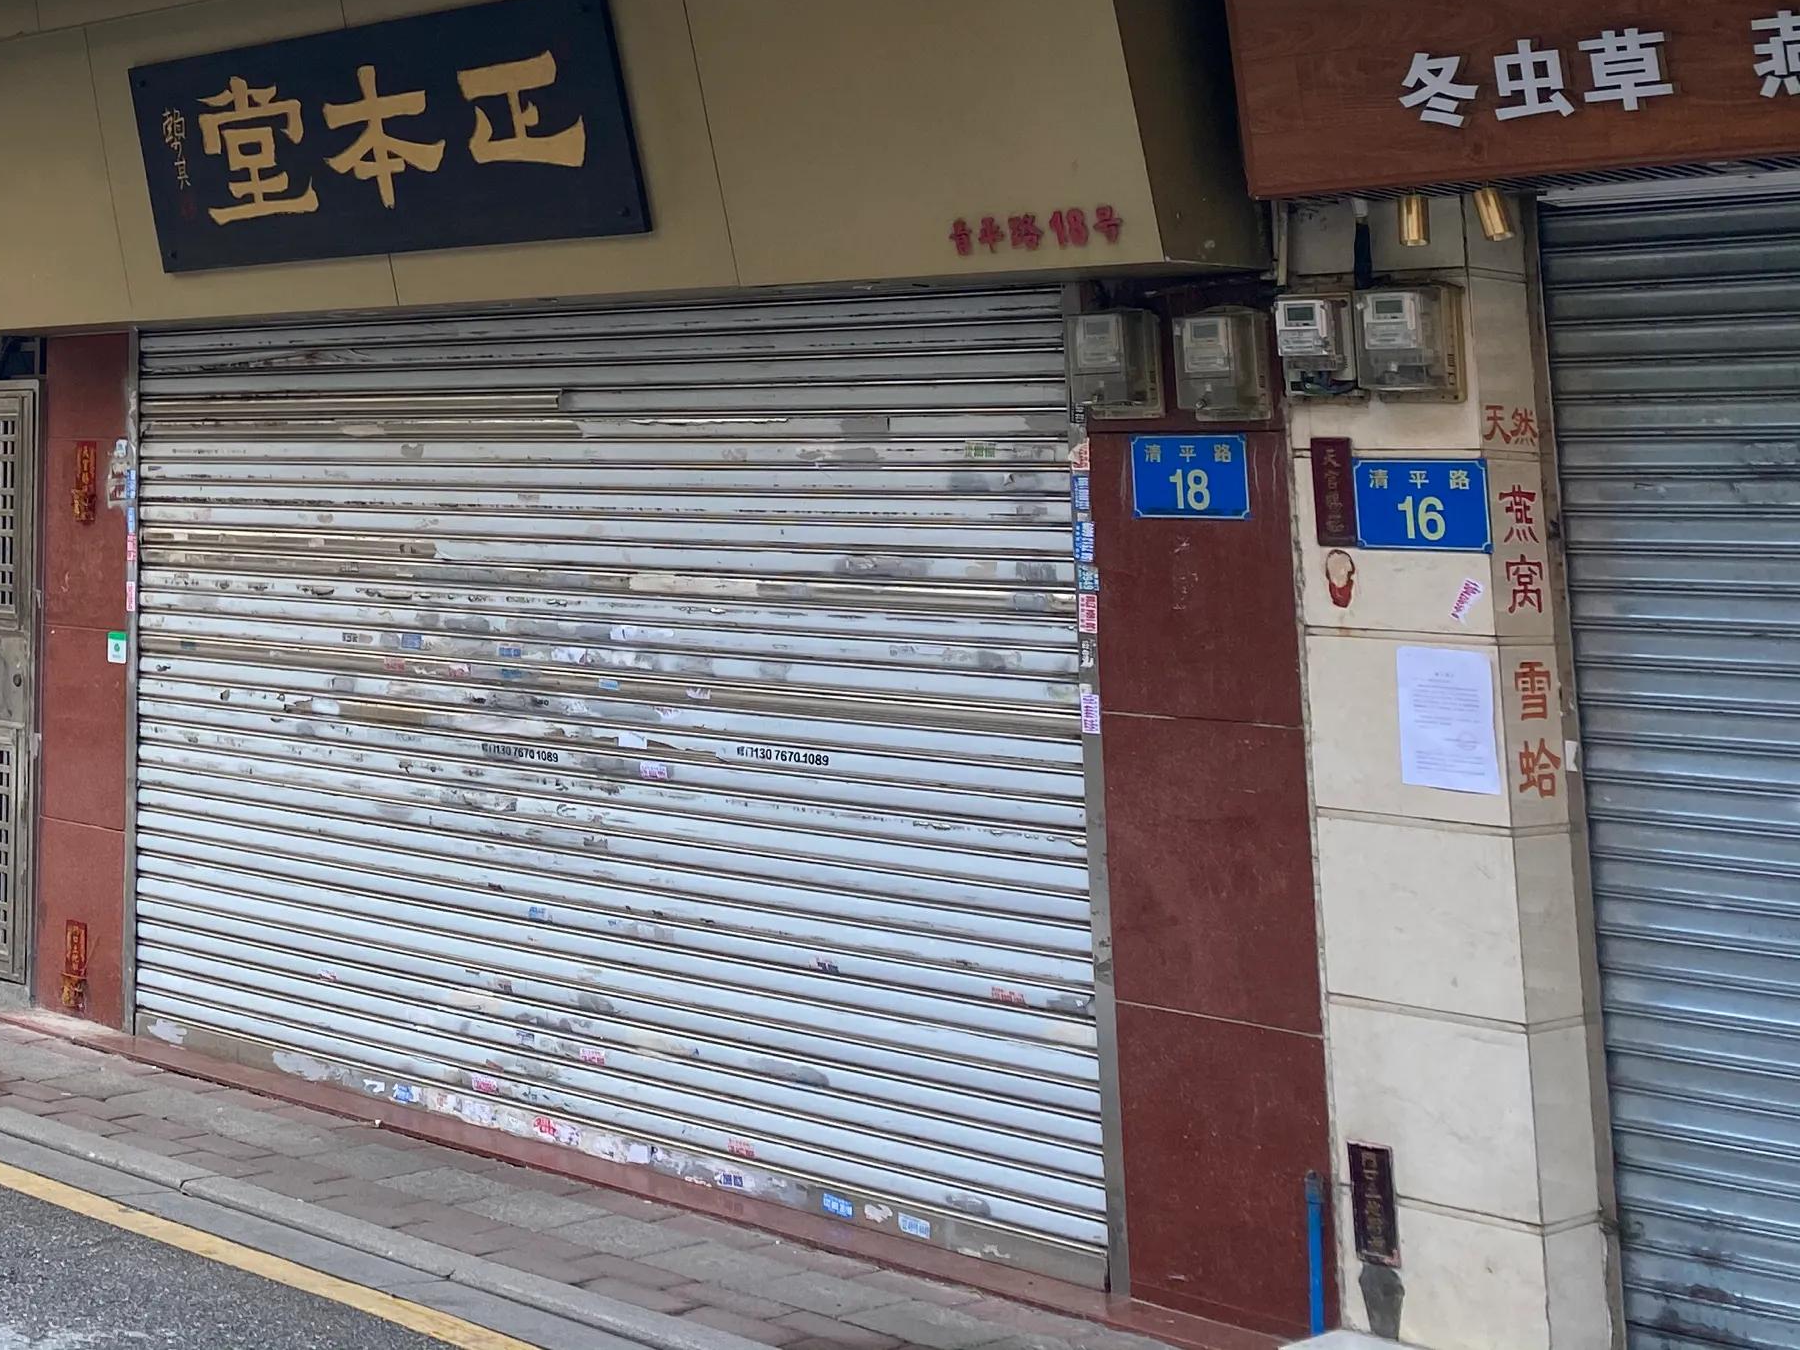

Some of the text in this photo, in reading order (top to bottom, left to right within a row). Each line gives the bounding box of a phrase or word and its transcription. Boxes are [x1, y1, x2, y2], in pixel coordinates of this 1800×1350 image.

[1399, 27, 1673, 127] 冬虫草
[1483, 403, 1539, 448] 天然
[1144, 443, 1233, 464] 清平路
[1169, 469, 1211, 511] 18
[1368, 468, 1472, 491] 清平路
[1397, 496, 1447, 542] 16
[1498, 484, 1545, 615] 燕窝
[1513, 661, 1562, 799] 雪蛤
[775, 749, 801, 763] 7670
[802, 753, 829, 766] 1089
